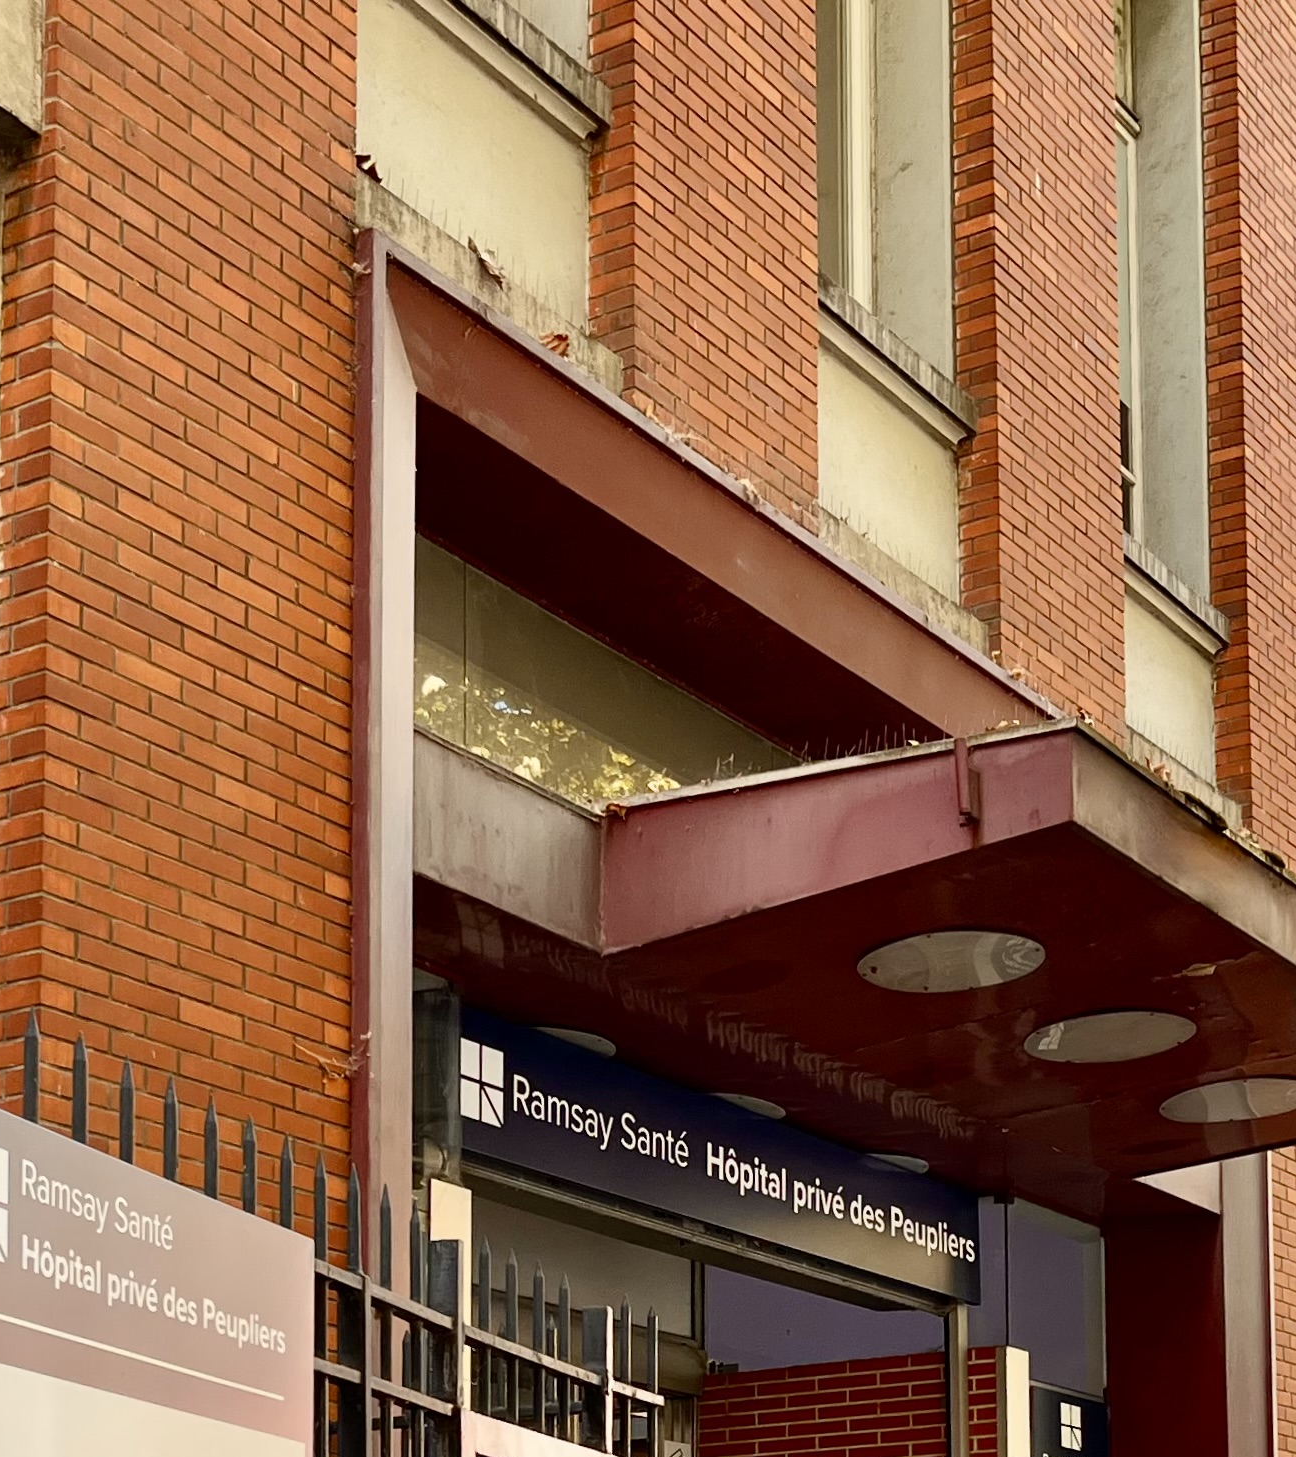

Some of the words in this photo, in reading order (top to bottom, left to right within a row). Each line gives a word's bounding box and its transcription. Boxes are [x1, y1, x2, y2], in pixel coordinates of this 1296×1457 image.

[21, 1158, 109, 1235] Ramsay
[115, 1196, 174, 1251] Santé
[513, 1074, 614, 1152] Ramsay
[621, 1113, 689, 1169] Santé
[707, 1142, 787, 1202] Hôpital
[793, 1179, 844, 1222] privé
[850, 1192, 885, 1234] des
[890, 1205, 976, 1264] Peupliers
[22, 1234, 103, 1294] Hôpital
[107, 1271, 158, 1313] privé
[163, 1286, 198, 1326] des
[203, 1298, 287, 1355] Peupliers
